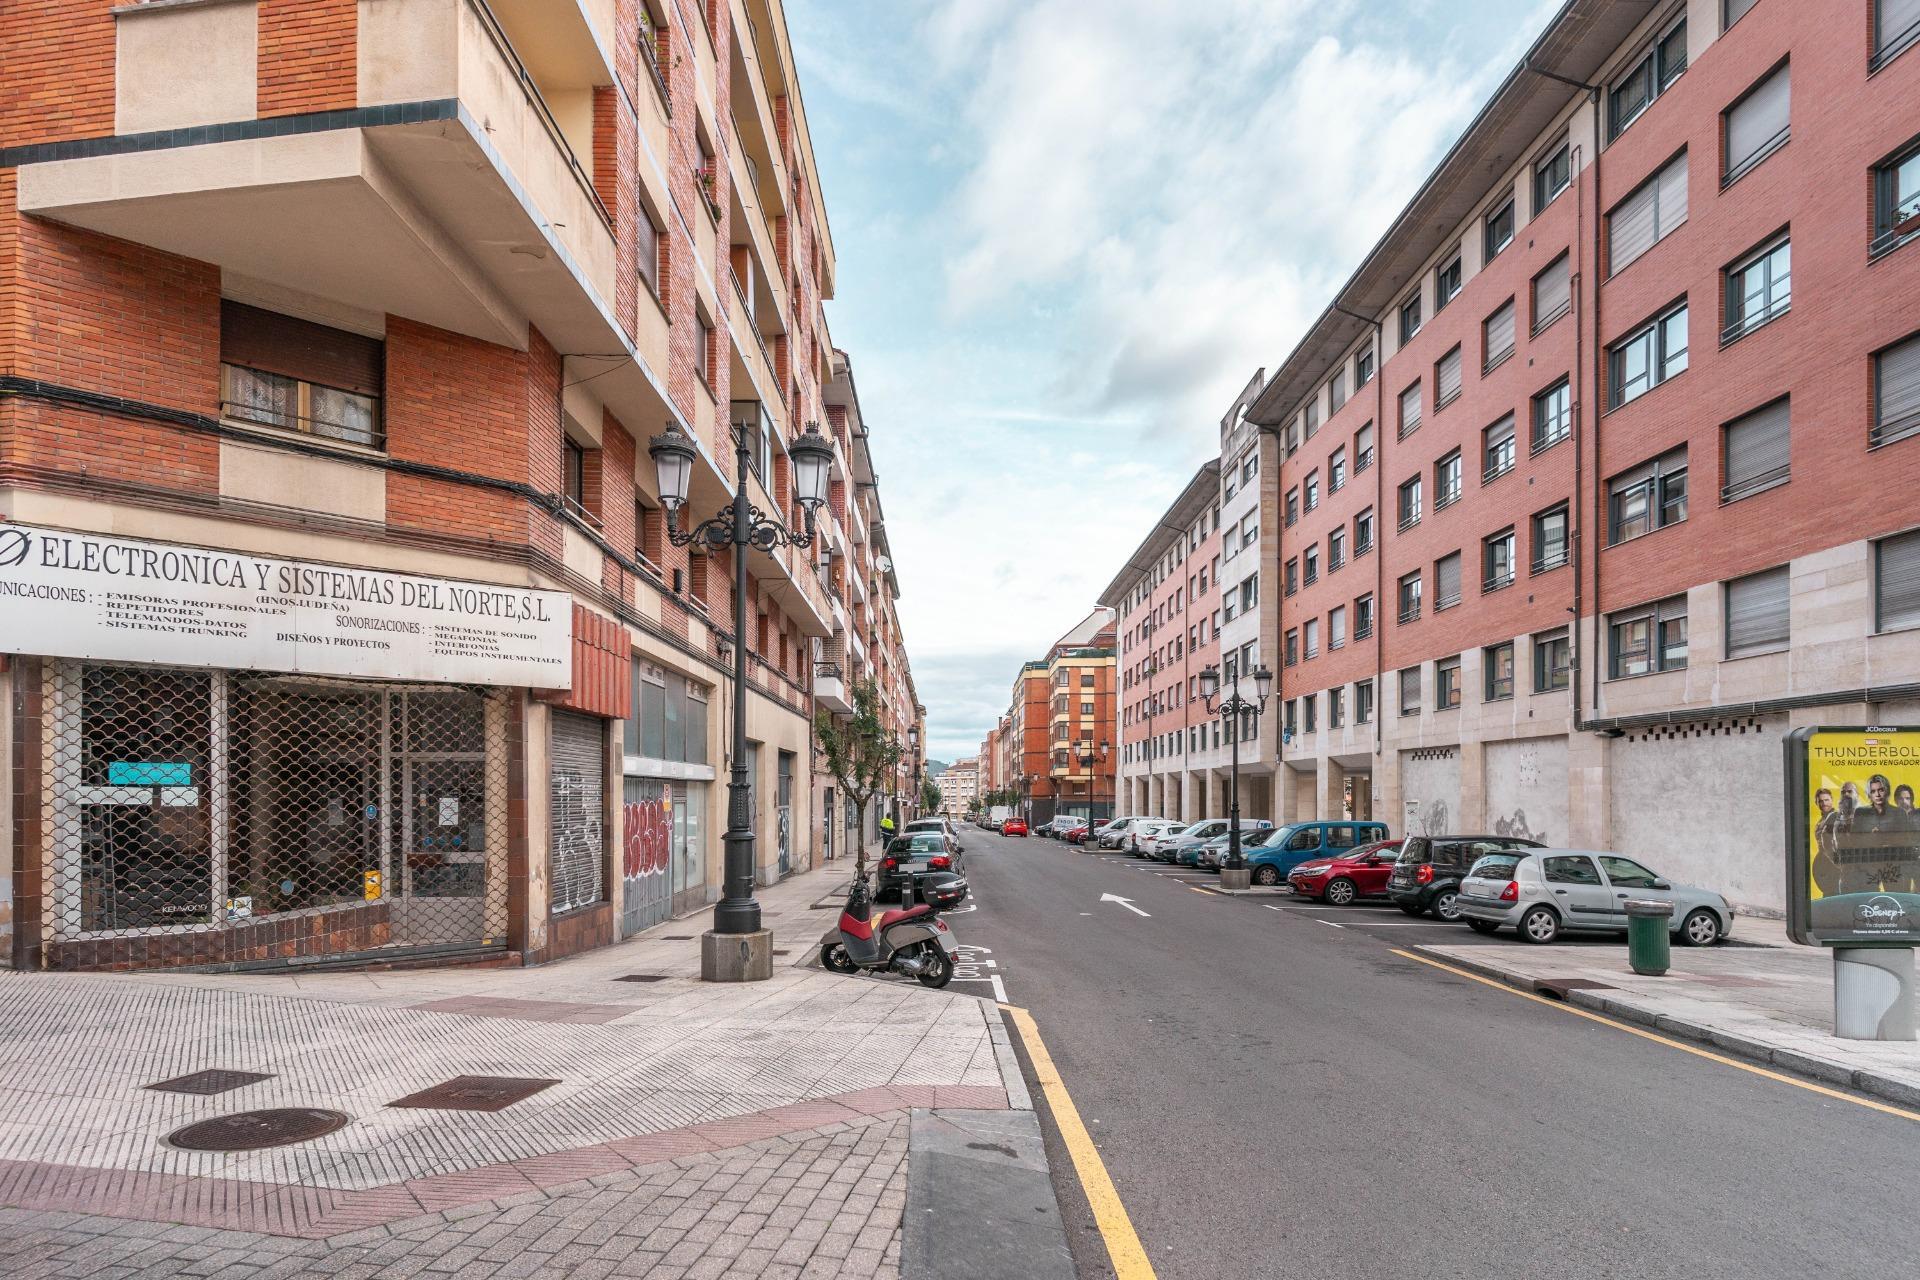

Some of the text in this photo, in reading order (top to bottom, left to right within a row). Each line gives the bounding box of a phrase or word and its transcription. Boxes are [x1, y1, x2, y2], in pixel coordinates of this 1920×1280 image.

[40, 536, 247, 590] ELECTRONICA
[254, 563, 271, 591] Y
[278, 566, 394, 605] SISTEMAS
[400, 581, 444, 610] DEL
[106, 592, 287, 616] EMISORAS PROFESIONALES
[106, 602, 204, 617] REPETIDORES
[105, 611, 247, 629] TELEMANDOS-DATOS
[105, 620, 248, 638] SISTEMAS TRUNKING
[434, 624, 483, 636] SISTEMAS
[500, 631, 537, 640] SONIDO
[276, 632, 391, 649] DISEÑOS Y PROYECTOS
[434, 632, 498, 644] MEGAFONIAS
[434, 640, 500, 652] INTERFONIAS
[434, 648, 562, 665] EQUIPOS INSTRUMENTALES
